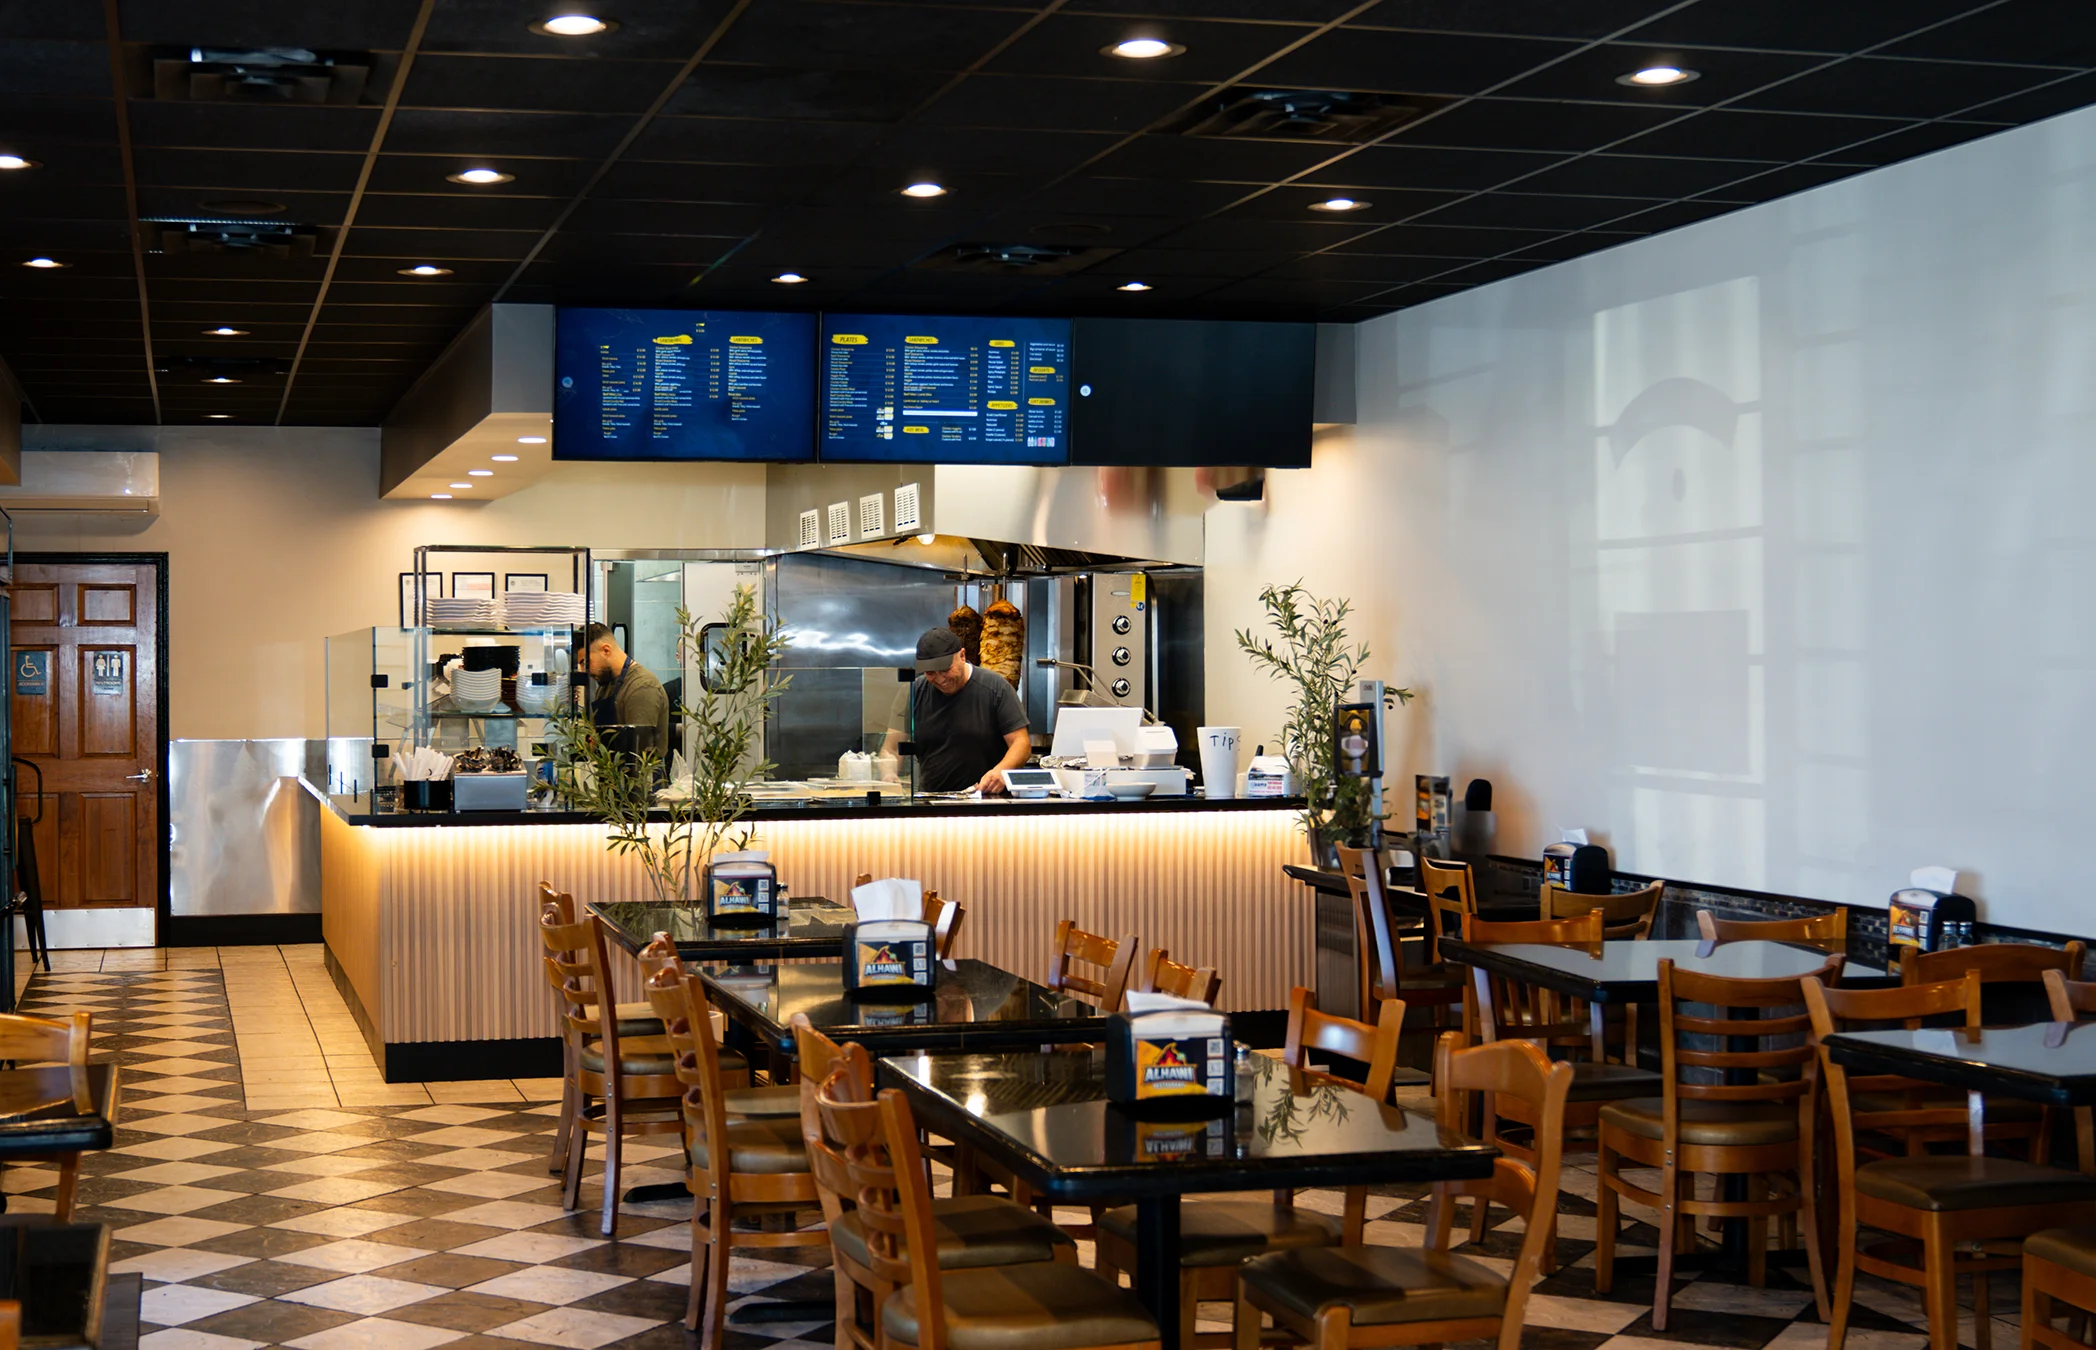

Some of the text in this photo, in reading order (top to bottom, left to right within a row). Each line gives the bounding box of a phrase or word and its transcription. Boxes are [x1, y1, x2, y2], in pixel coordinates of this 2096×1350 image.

[720, 896, 749, 905] ALHAWI
[864, 963, 903, 975] ALHAWI
[1144, 1066, 1194, 1082] ALHAWI
